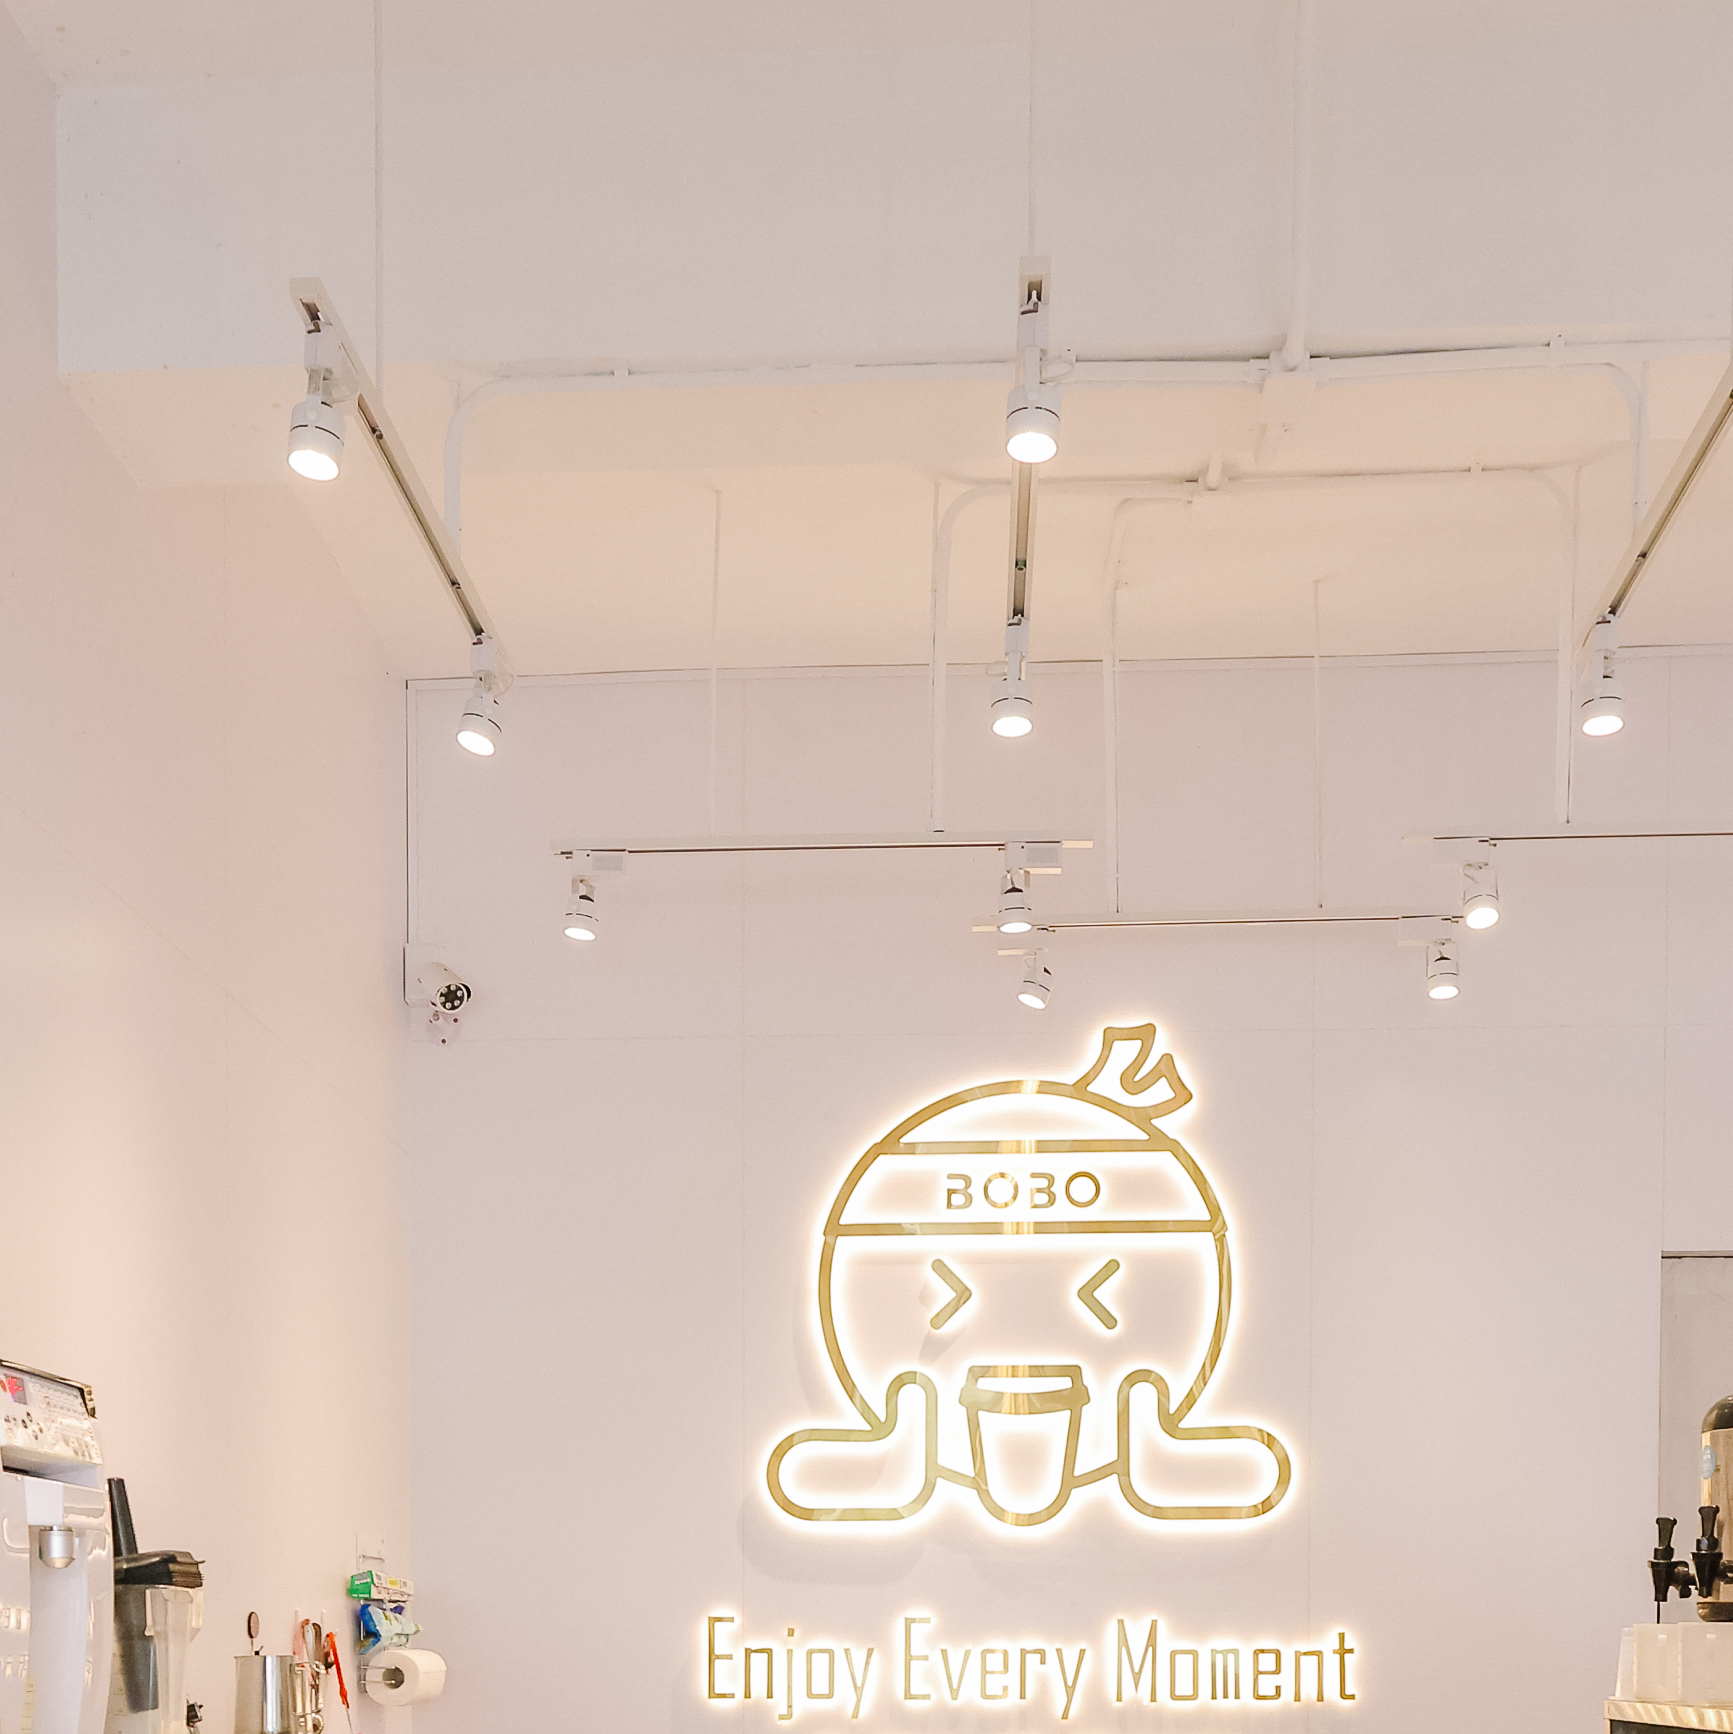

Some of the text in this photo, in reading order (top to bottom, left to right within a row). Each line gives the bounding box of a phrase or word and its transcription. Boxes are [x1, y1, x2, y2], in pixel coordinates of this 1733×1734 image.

[947, 1171, 1101, 1210] BOBO
[706, 1616, 1357, 1720] Enjoy Every Moment
